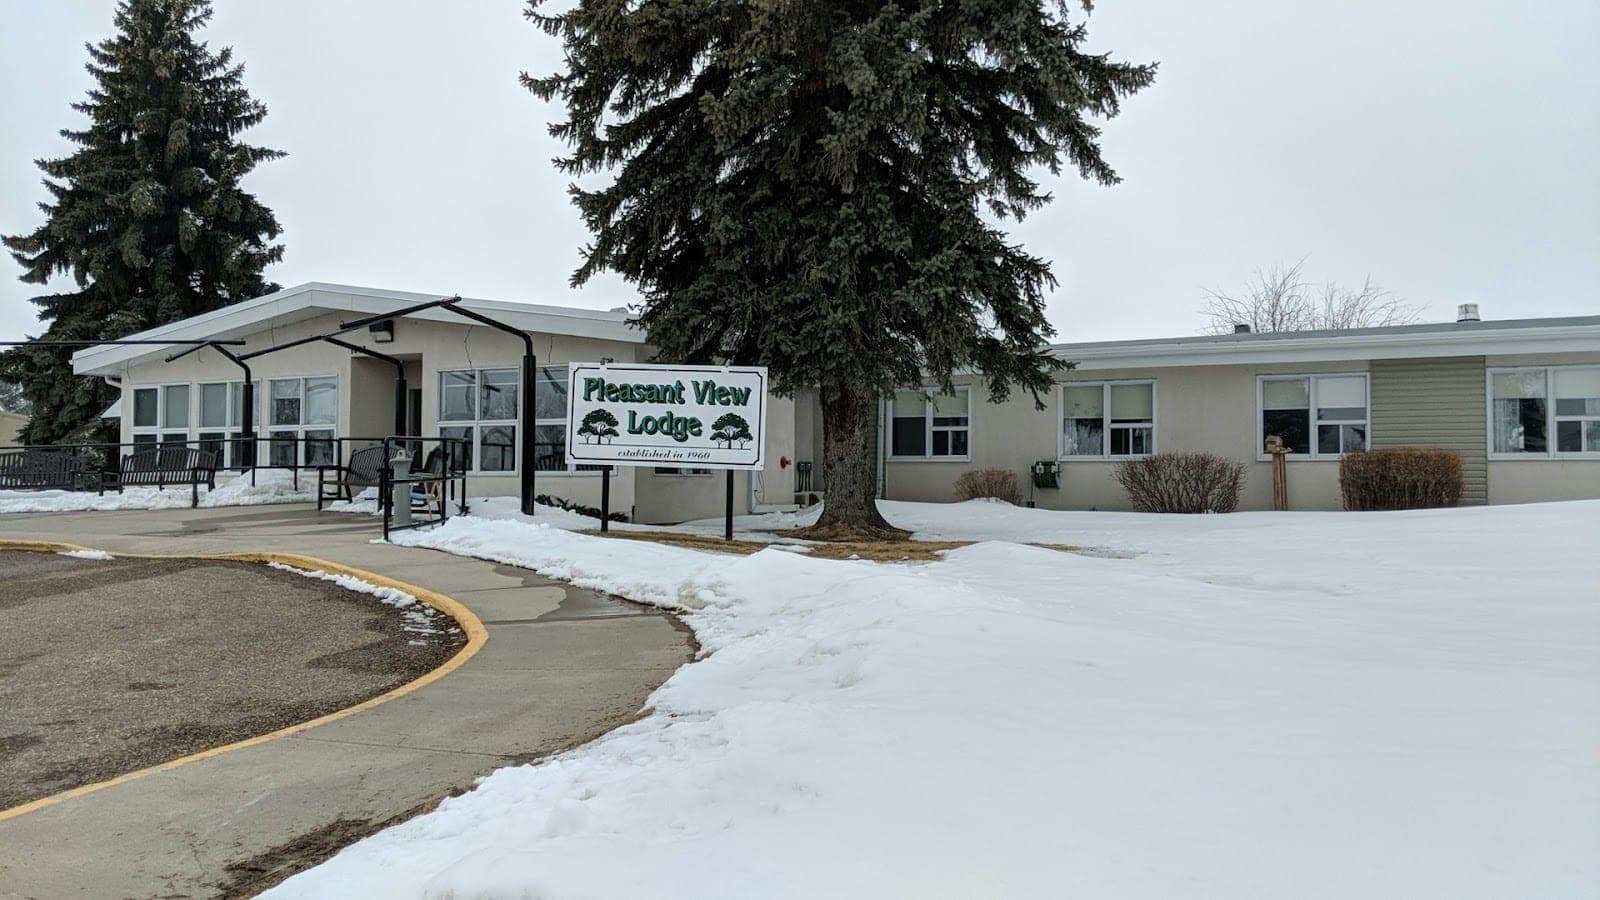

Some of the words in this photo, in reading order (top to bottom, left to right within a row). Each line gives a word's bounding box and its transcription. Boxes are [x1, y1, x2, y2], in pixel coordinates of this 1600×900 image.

[583, 377, 686, 405] Pleasant
[691, 379, 752, 406] View
[626, 410, 703, 442] Lodge
[617, 449, 671, 459] established
[673, 450, 683, 459] in
[687, 451, 711, 460] 1960
